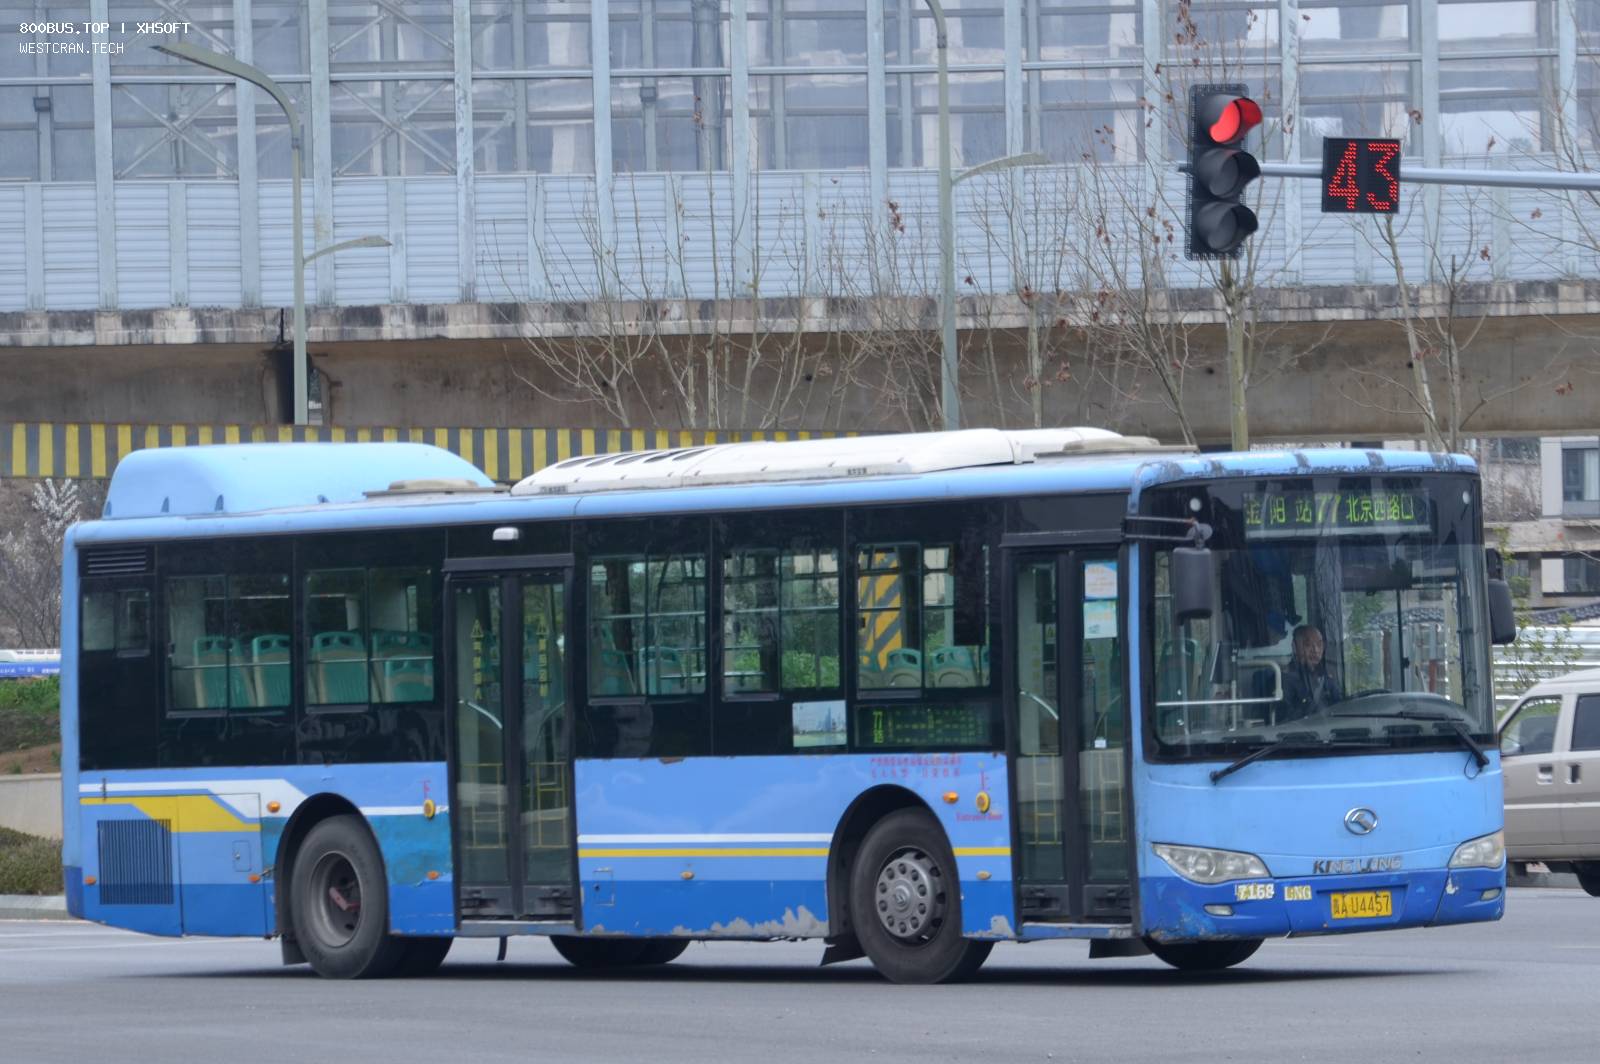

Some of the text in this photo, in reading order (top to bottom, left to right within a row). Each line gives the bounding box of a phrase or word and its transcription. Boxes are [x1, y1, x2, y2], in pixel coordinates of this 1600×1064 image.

[1328, 142, 1399, 210] 43
[1318, 495, 1341, 523] 77
[1346, 494, 1414, 522] 北京西路口
[1313, 859, 1353, 874] KING
